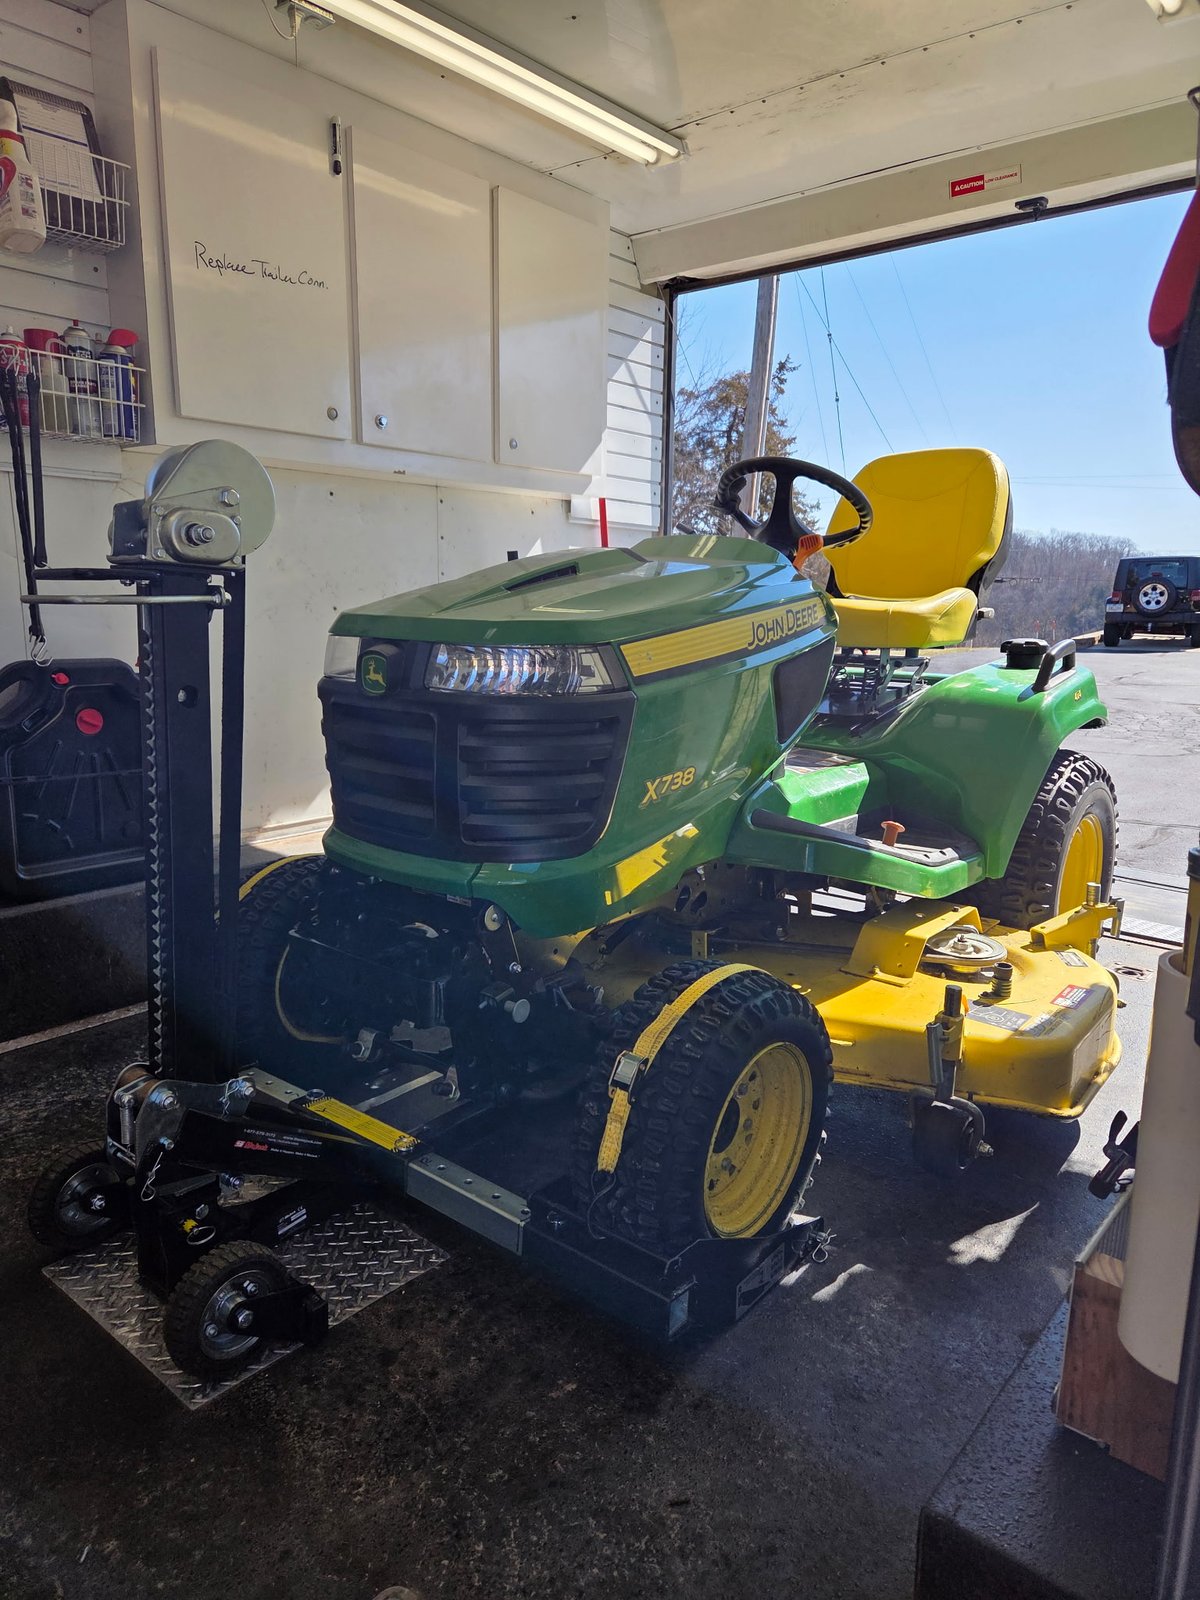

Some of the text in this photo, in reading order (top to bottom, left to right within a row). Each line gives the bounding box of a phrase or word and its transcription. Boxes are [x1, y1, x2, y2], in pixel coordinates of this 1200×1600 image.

[960, 180, 984, 190] CAUTION
[995, 172, 1018, 181] CLEARANCE
[194, 240, 255, 276] Replace
[251, 259, 297, 285] Trailer
[747, 602, 819, 648] JOHN DEERE
[640, 766, 696, 804] X738
